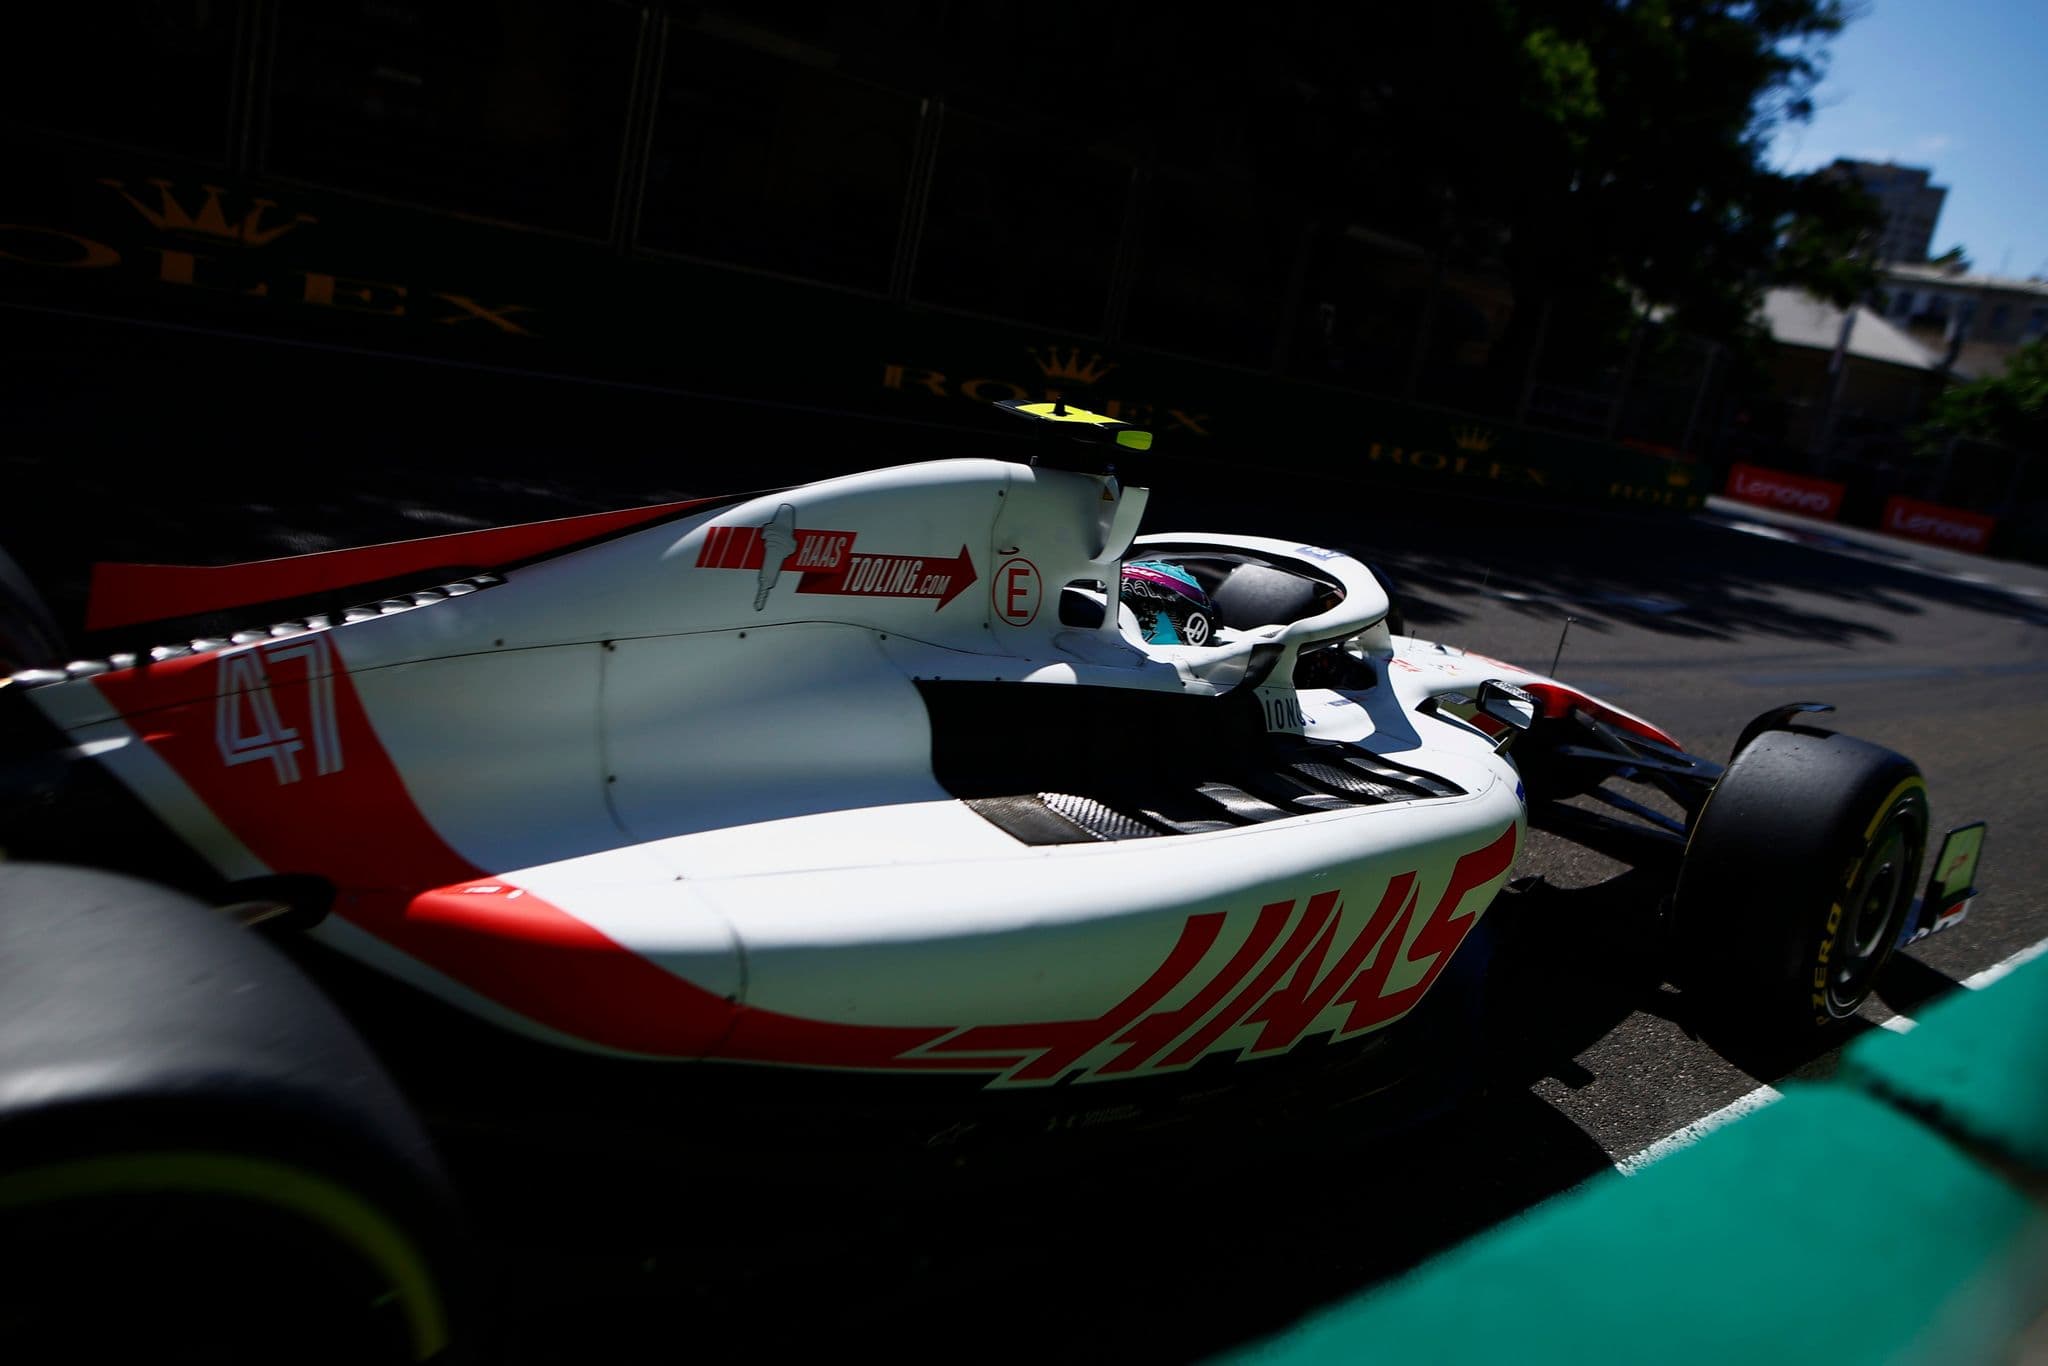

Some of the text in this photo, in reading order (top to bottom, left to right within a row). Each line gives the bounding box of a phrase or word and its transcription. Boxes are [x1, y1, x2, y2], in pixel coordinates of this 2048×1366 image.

[1735, 472, 1830, 513] Lenovo
[796, 535, 847, 568] HAAS
[1006, 567, 1030, 618] E
[214, 630, 345, 786] 47
[1002, 820, 1516, 1084] HAAS
[1811, 901, 1842, 1009] ZERO
